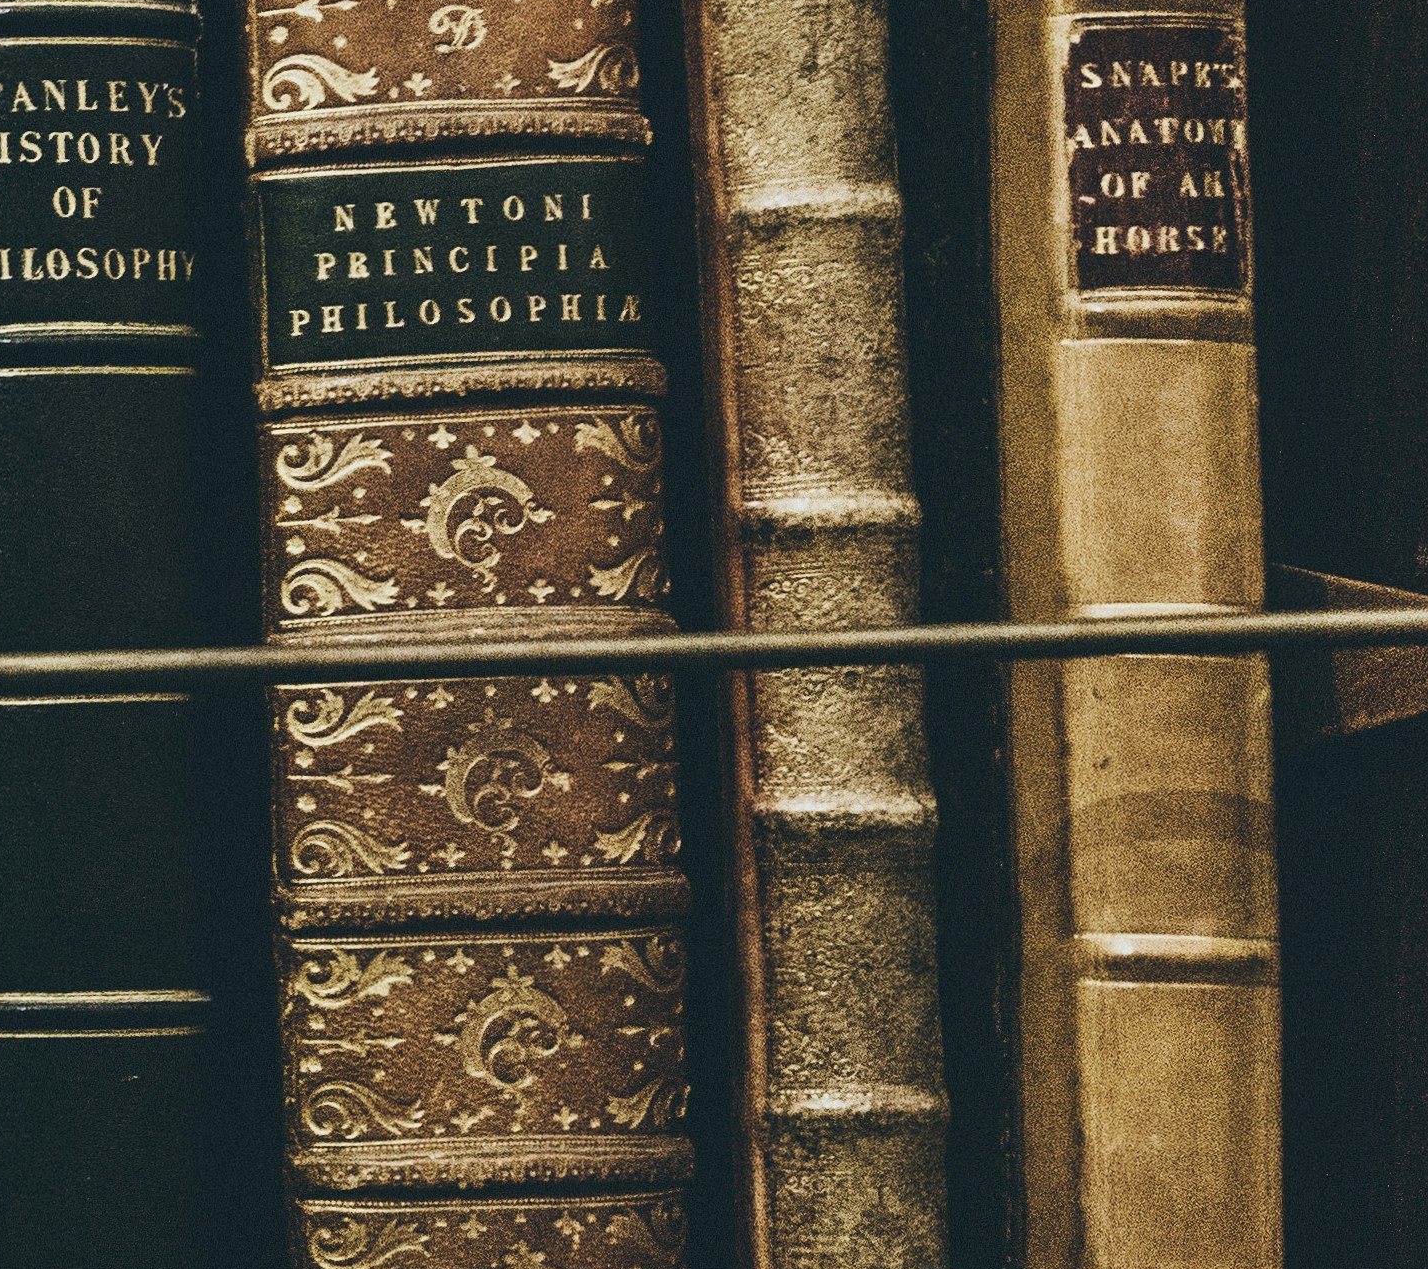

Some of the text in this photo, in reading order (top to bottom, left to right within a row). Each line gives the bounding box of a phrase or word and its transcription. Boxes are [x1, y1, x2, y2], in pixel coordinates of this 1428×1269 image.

[51, 185, 103, 219] OF
[1100, 171, 1225, 198] OF AN
[333, 193, 593, 232] NEWTONI
[1092, 225, 1229, 256] HORSE
[315, 244, 611, 280] PRINCIPIA
[289, 293, 642, 338] PHILOSOPHIÆ
